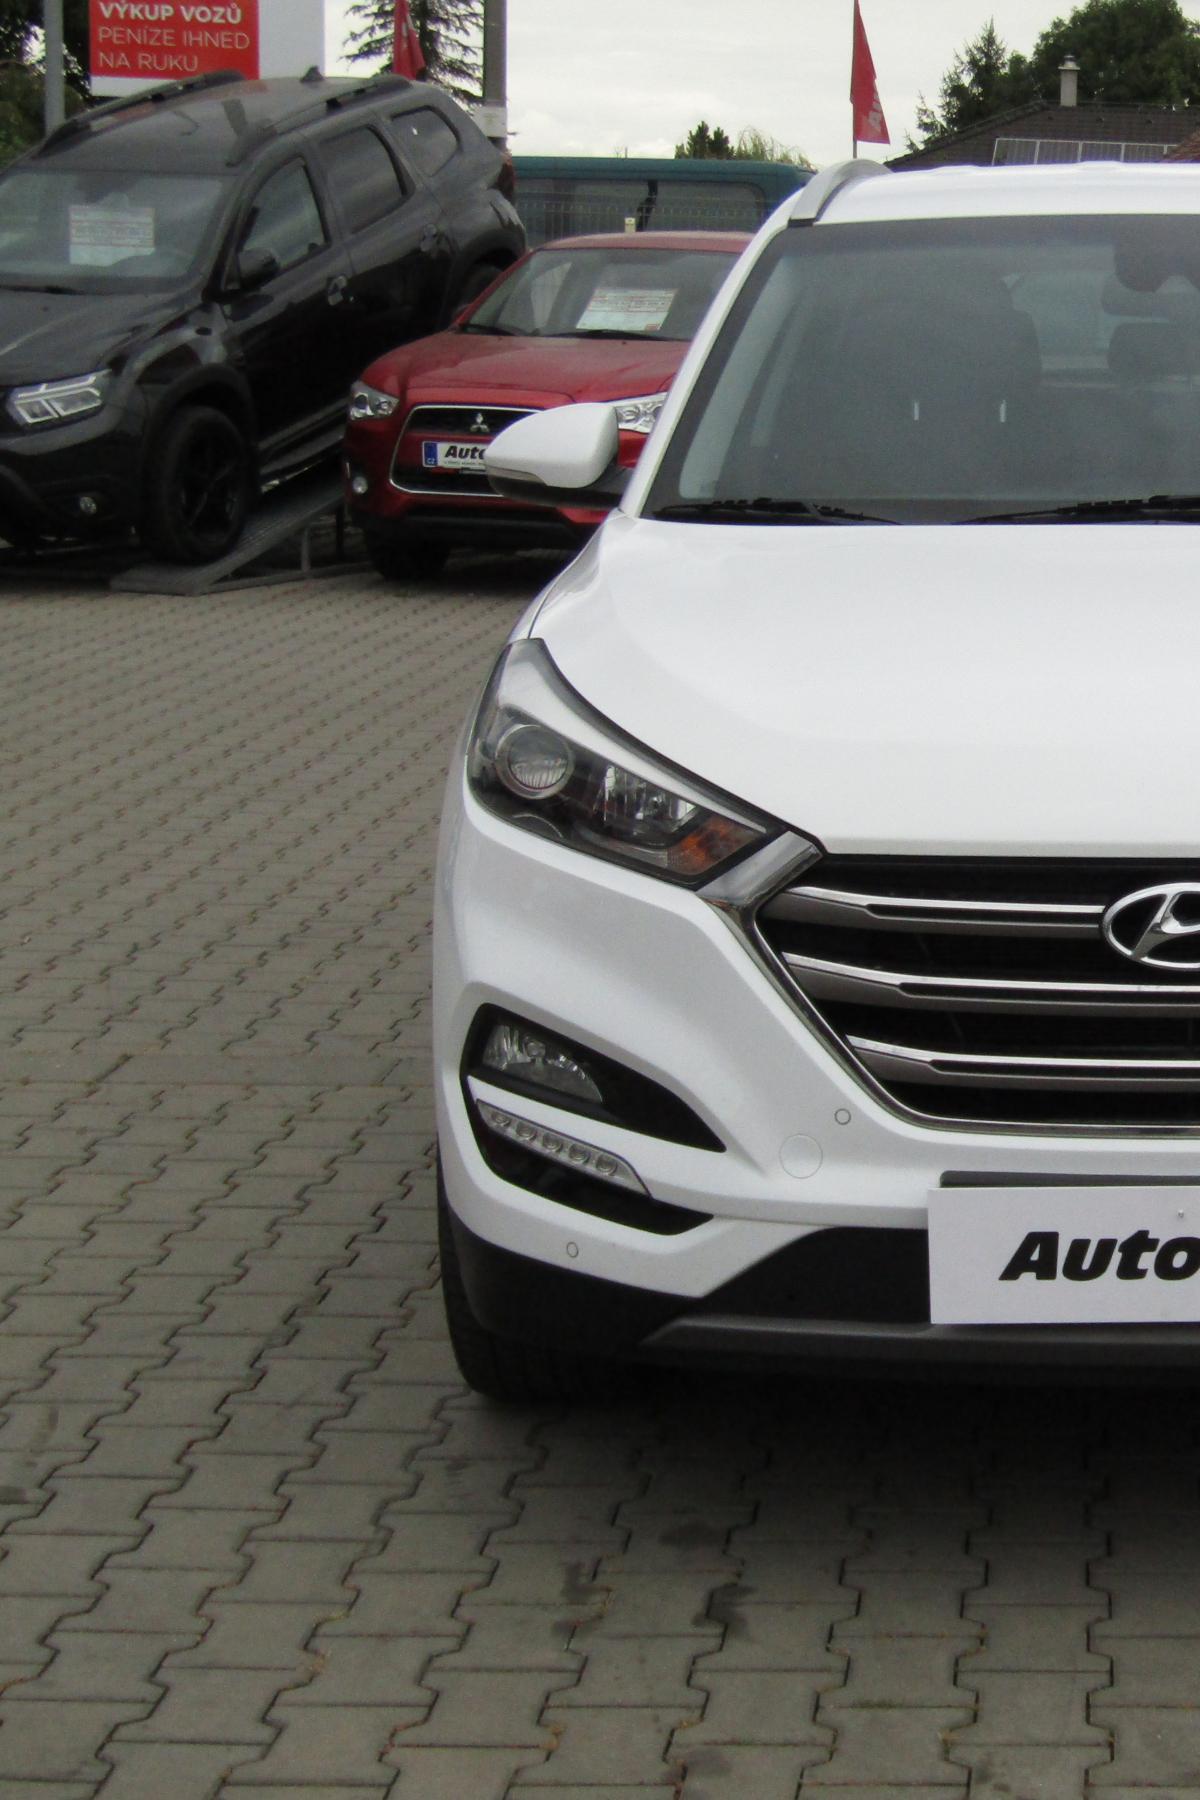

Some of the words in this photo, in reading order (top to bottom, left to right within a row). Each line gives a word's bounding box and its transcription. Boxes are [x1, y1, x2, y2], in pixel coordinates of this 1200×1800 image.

[99, 0, 174, 20] VÝKUP
[180, 3, 242, 24] VOZŮ
[98, 26, 176, 47] PENÍZE
[182, 31, 250, 49] IHNED
[98, 52, 130, 69] NA
[138, 53, 198, 72] RUKU
